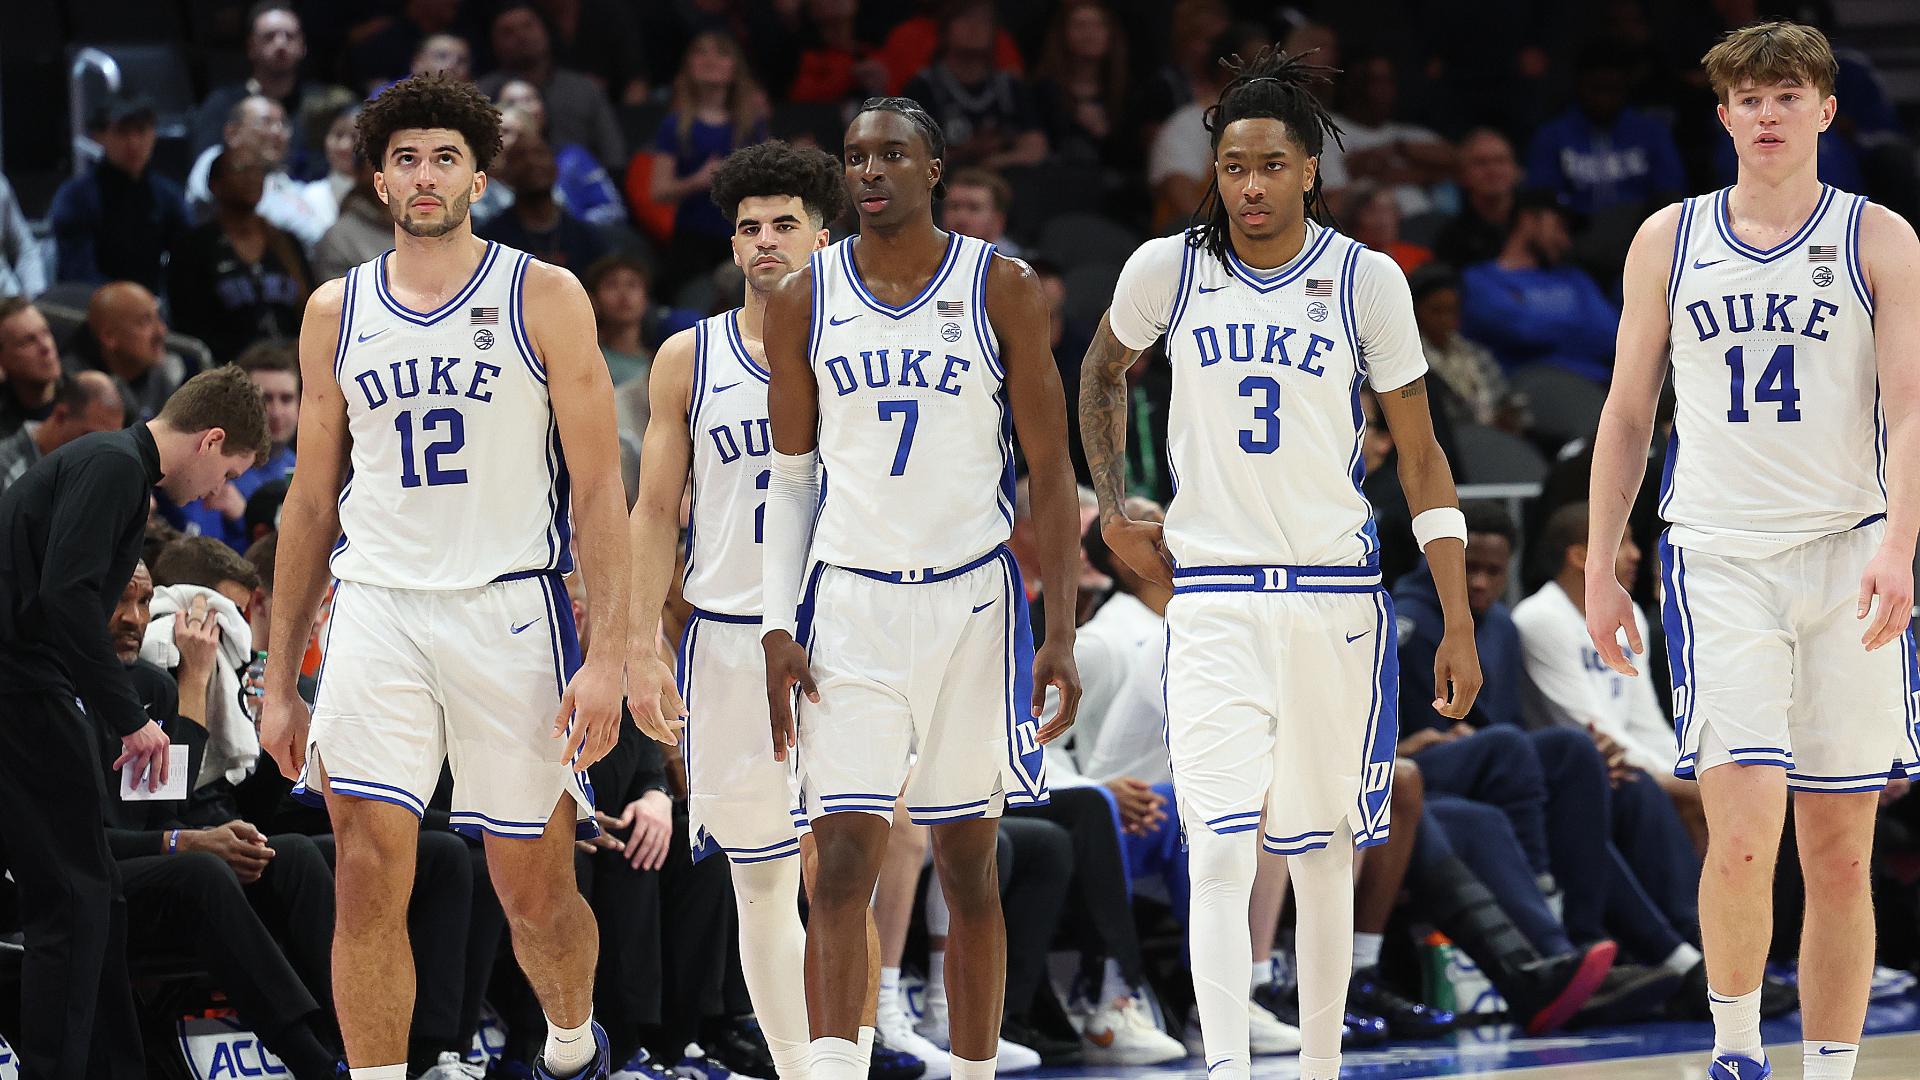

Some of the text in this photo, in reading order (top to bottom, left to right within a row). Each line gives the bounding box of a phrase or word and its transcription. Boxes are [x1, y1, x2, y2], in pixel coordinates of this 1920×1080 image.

[1685, 293, 1840, 342] DUKE
[825, 348, 971, 397] DUKE
[1192, 323, 1336, 378] DUKE
[354, 356, 502, 411] DUKE
[1724, 344, 1801, 423] 14
[877, 399, 919, 477] 7
[1238, 375, 1281, 455] 3
[394, 407, 469, 489] 12
[709, 418, 771, 465] DU
[1262, 567, 1288, 590] D
[1016, 720, 1040, 756] D
[1365, 761, 1391, 794] D
